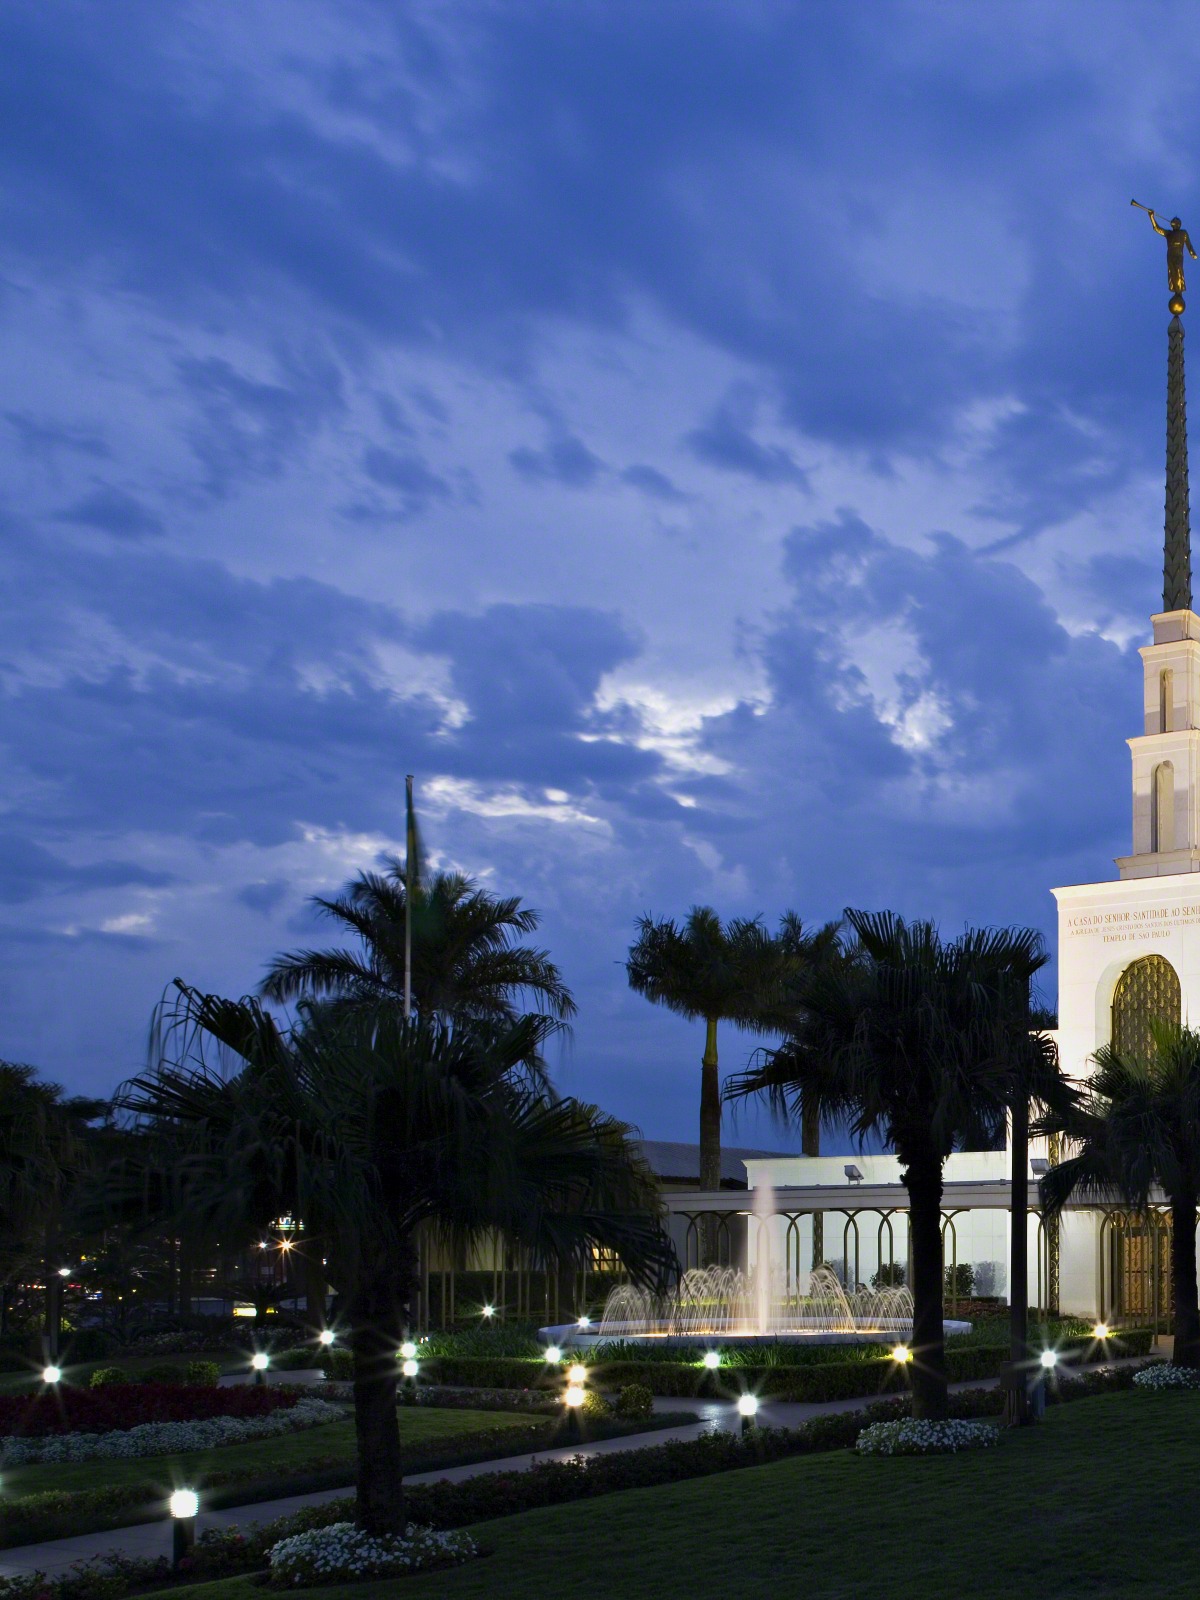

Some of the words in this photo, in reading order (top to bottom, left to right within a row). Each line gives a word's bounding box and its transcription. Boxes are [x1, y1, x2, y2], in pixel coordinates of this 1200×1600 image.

[1073, 916, 1092, 926] CASA
[1093, 915, 1103, 924] DO
[1104, 912, 1130, 924] SENHOR
[1132, 908, 1169, 921] SANTIDADE
[1171, 907, 1180, 917] AO
[1103, 933, 1127, 943] TEMPLO
[1128, 932, 1135, 941] DE
[1151, 930, 1171, 939] PAULO
